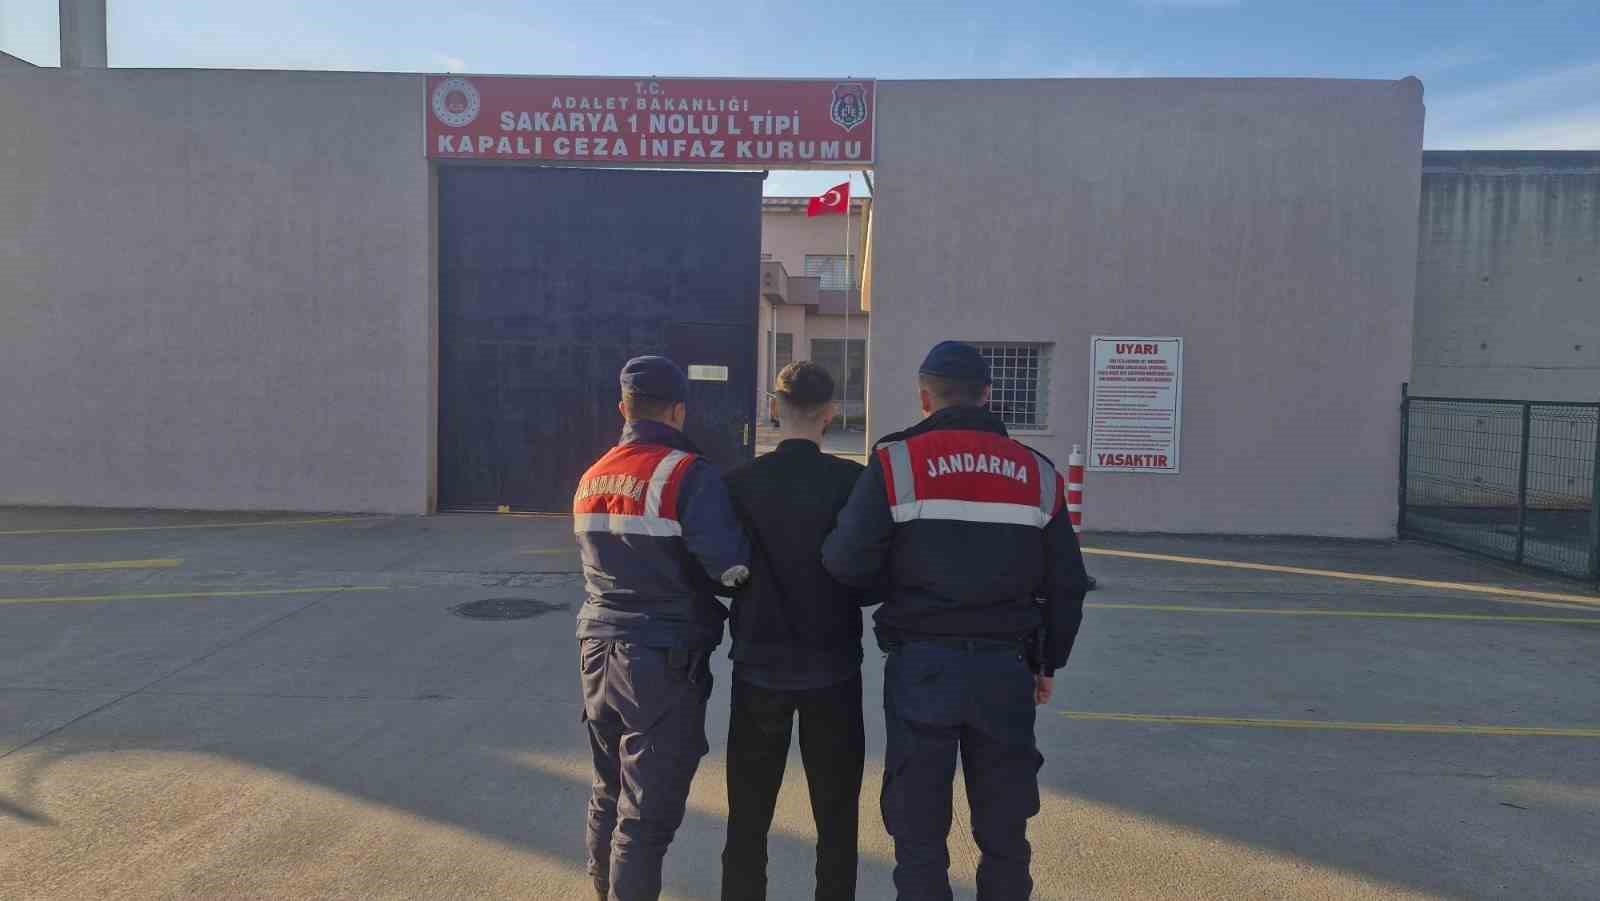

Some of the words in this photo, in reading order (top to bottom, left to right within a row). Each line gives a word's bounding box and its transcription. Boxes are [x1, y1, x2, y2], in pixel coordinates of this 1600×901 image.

[551, 96, 629, 110] ADALET
[637, 96, 749, 112] BAKANLIĞI
[500, 111, 618, 132] SAKARYA
[628, 114, 638, 133] 1
[650, 113, 719, 134] NOLU
[728, 114, 740, 135] L
[750, 110, 800, 135] TİPİ
[438, 135, 543, 154] KAPALI
[553, 136, 629, 156] CEZA
[639, 133, 725, 158] İNFAZ
[736, 140, 861, 159] KURUMU
[1116, 343, 1158, 354] UYARI
[927, 453, 1028, 484] JANDARMA
[1097, 453, 1168, 467] YASAKTIR
